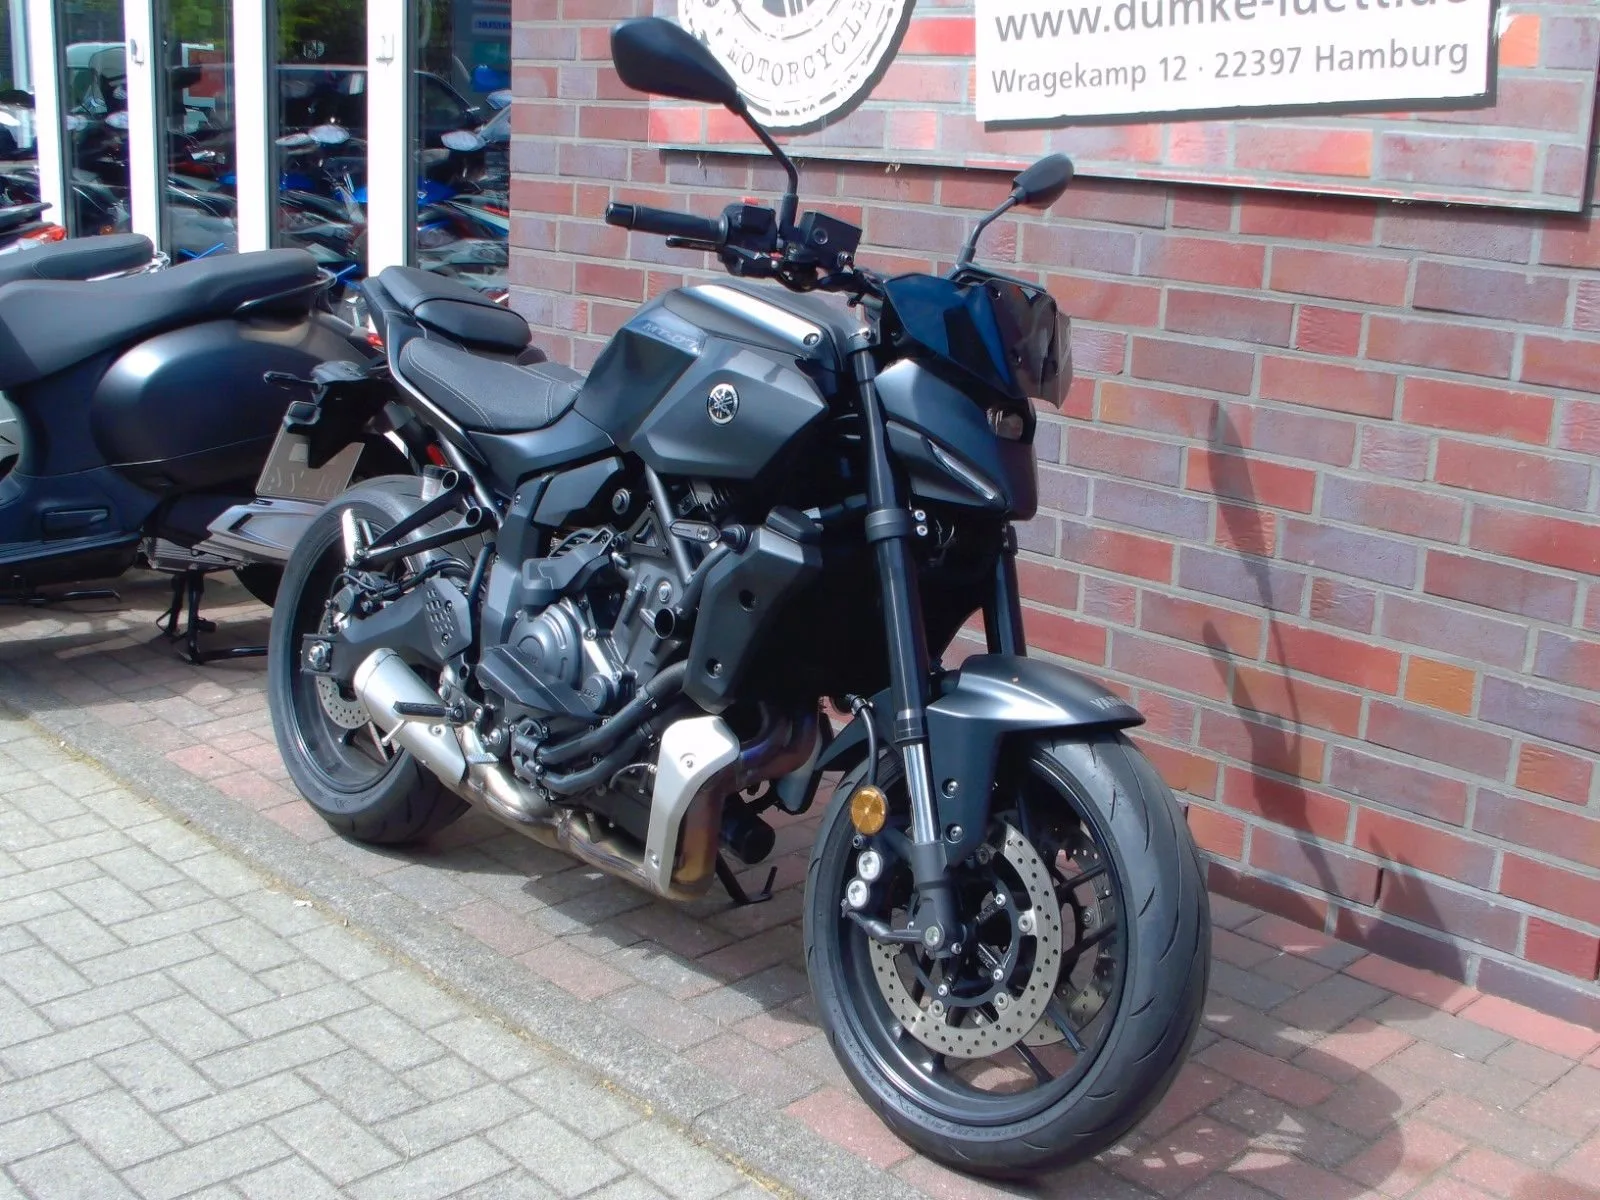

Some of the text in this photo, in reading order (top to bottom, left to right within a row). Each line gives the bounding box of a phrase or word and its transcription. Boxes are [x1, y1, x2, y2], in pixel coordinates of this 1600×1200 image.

[995, 0, 1468, 42] www.dumke-u.
[992, 62, 1146, 97] Wragekamp
[1159, 56, 1187, 82] 12
[1214, 47, 1302, 79] 22397
[1315, 38, 1469, 74] Hamburg
